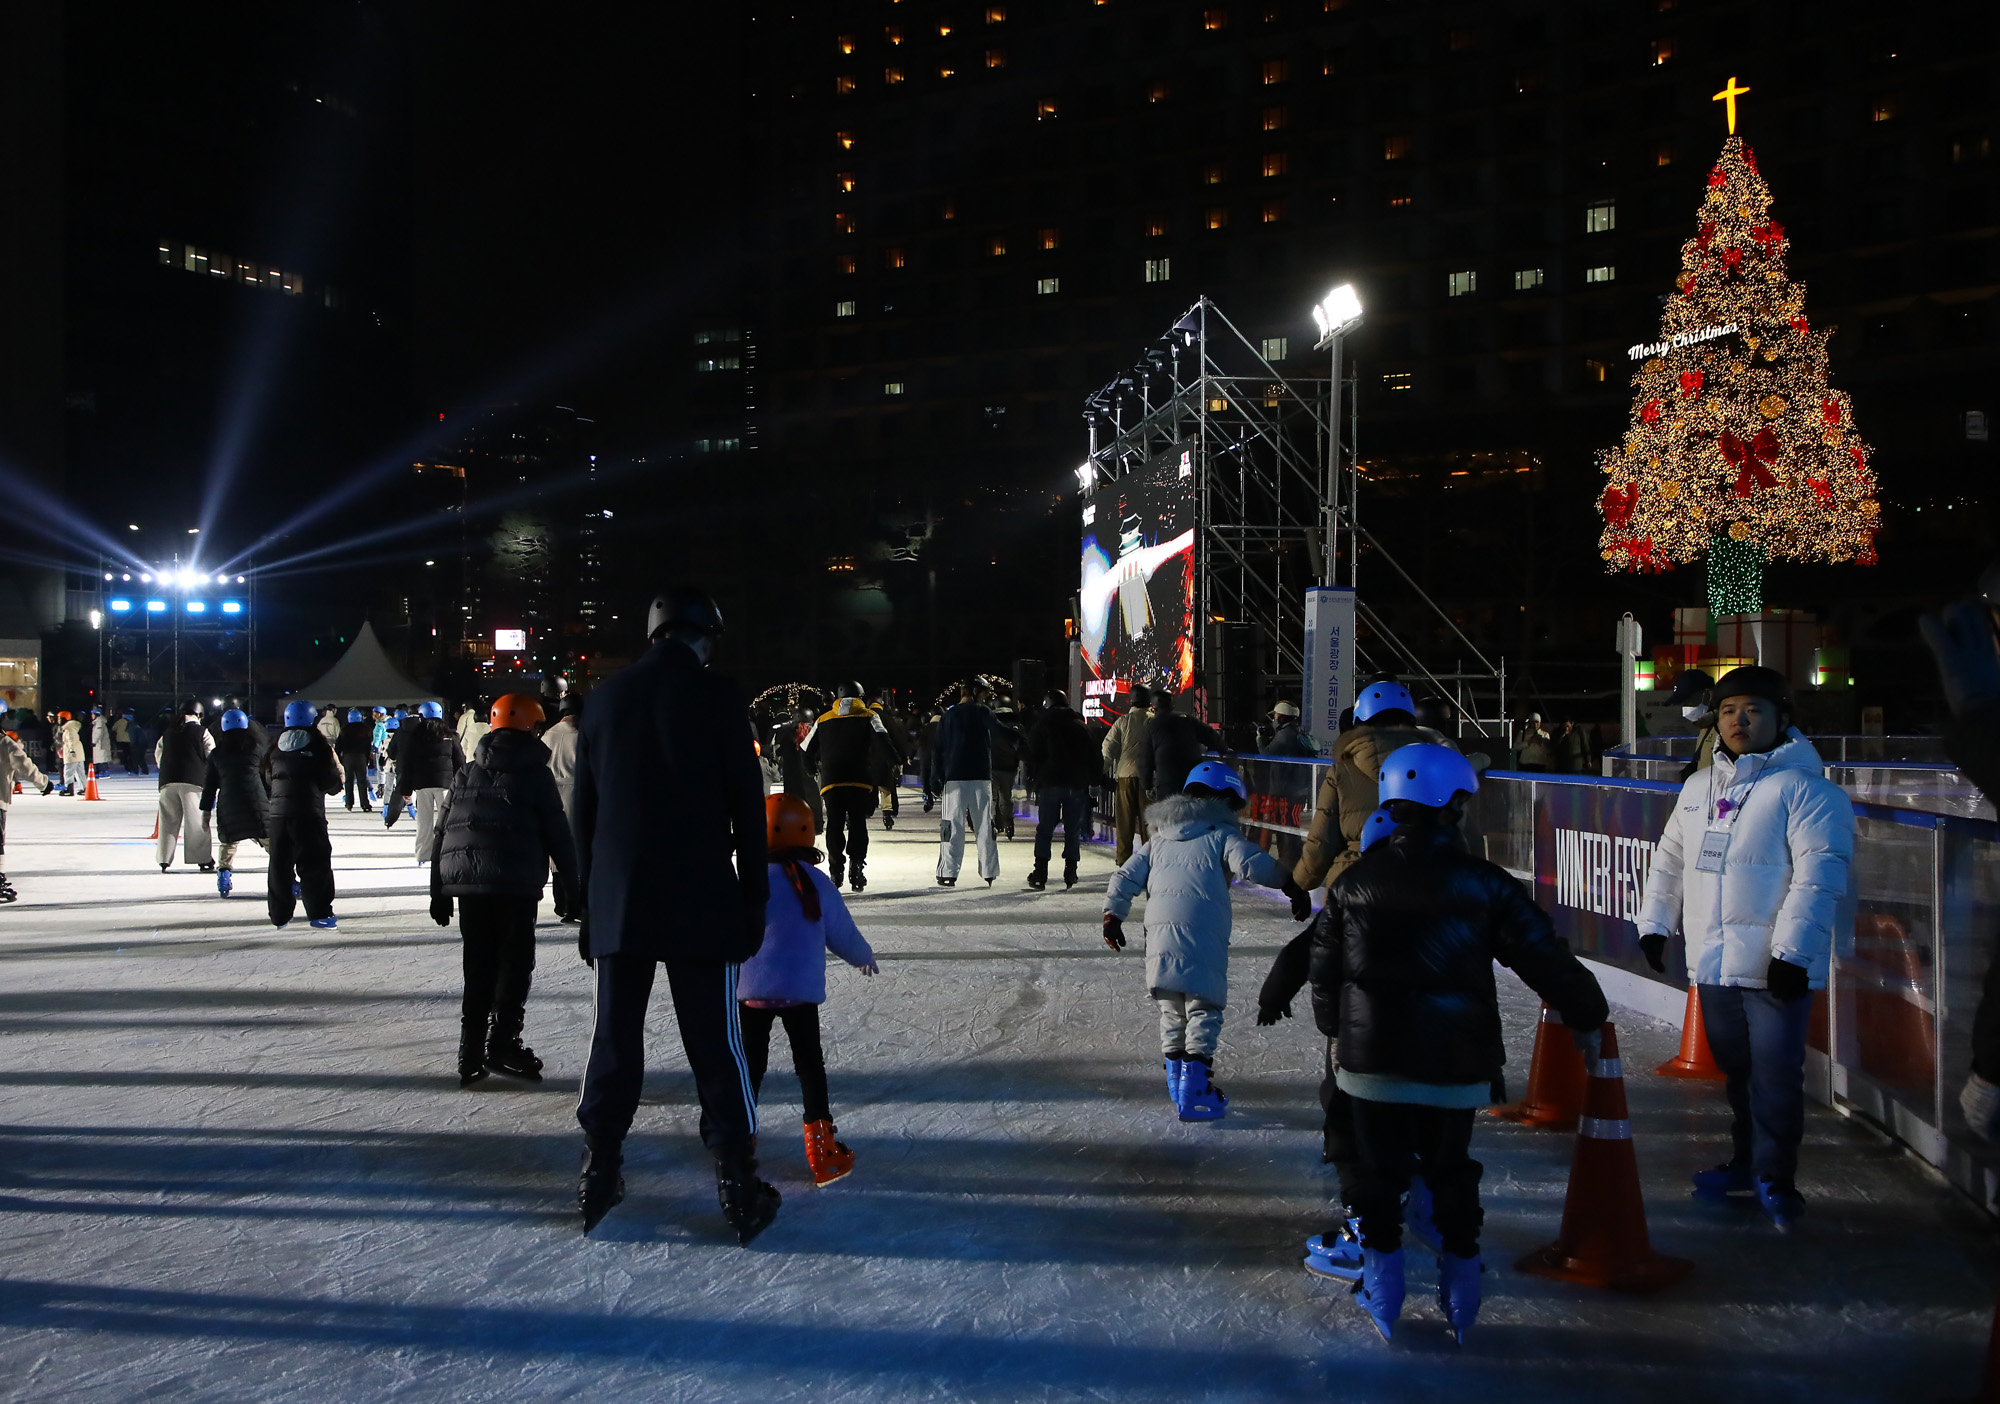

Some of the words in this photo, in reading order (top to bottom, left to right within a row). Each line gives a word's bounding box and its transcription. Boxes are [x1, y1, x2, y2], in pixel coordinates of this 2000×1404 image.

[1628, 340, 1670, 360] Merry
[1672, 322, 1739, 348] Christmas
[1329, 626, 1340, 671] 서울광장
[1327, 675, 1339, 731] 스케이트장
[1555, 828, 1611, 917] WINTER
